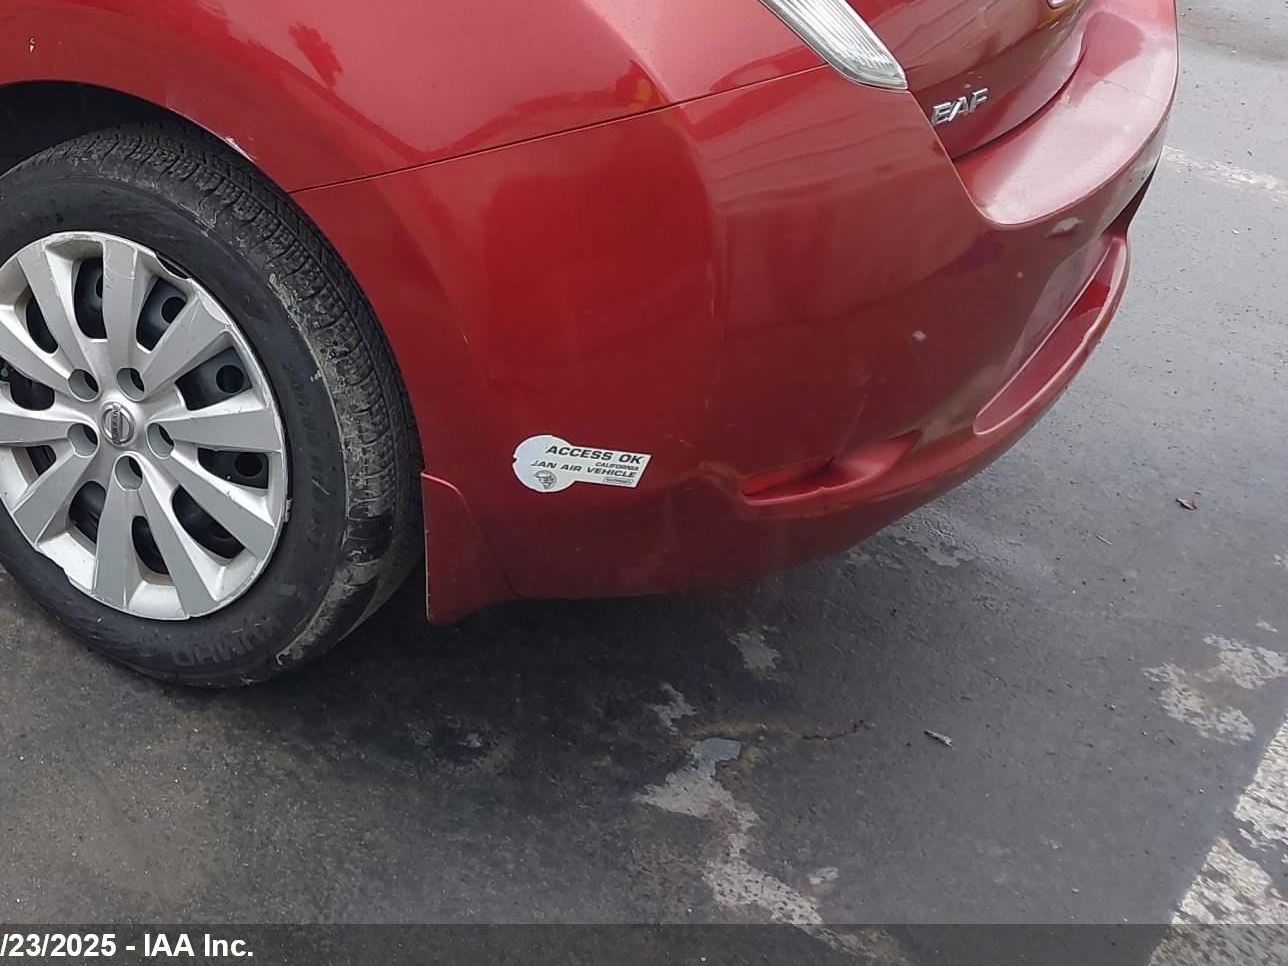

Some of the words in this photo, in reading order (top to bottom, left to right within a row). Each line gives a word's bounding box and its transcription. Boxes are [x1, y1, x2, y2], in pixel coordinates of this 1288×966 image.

[931, 87, 988, 126] EAF
[545, 445, 614, 461] ACCESS
[618, 454, 643, 464] OK
[560, 464, 582, 472] AIR
[587, 467, 638, 478] VEHICLE
[595, 461, 639, 472] CALIFORNIA
